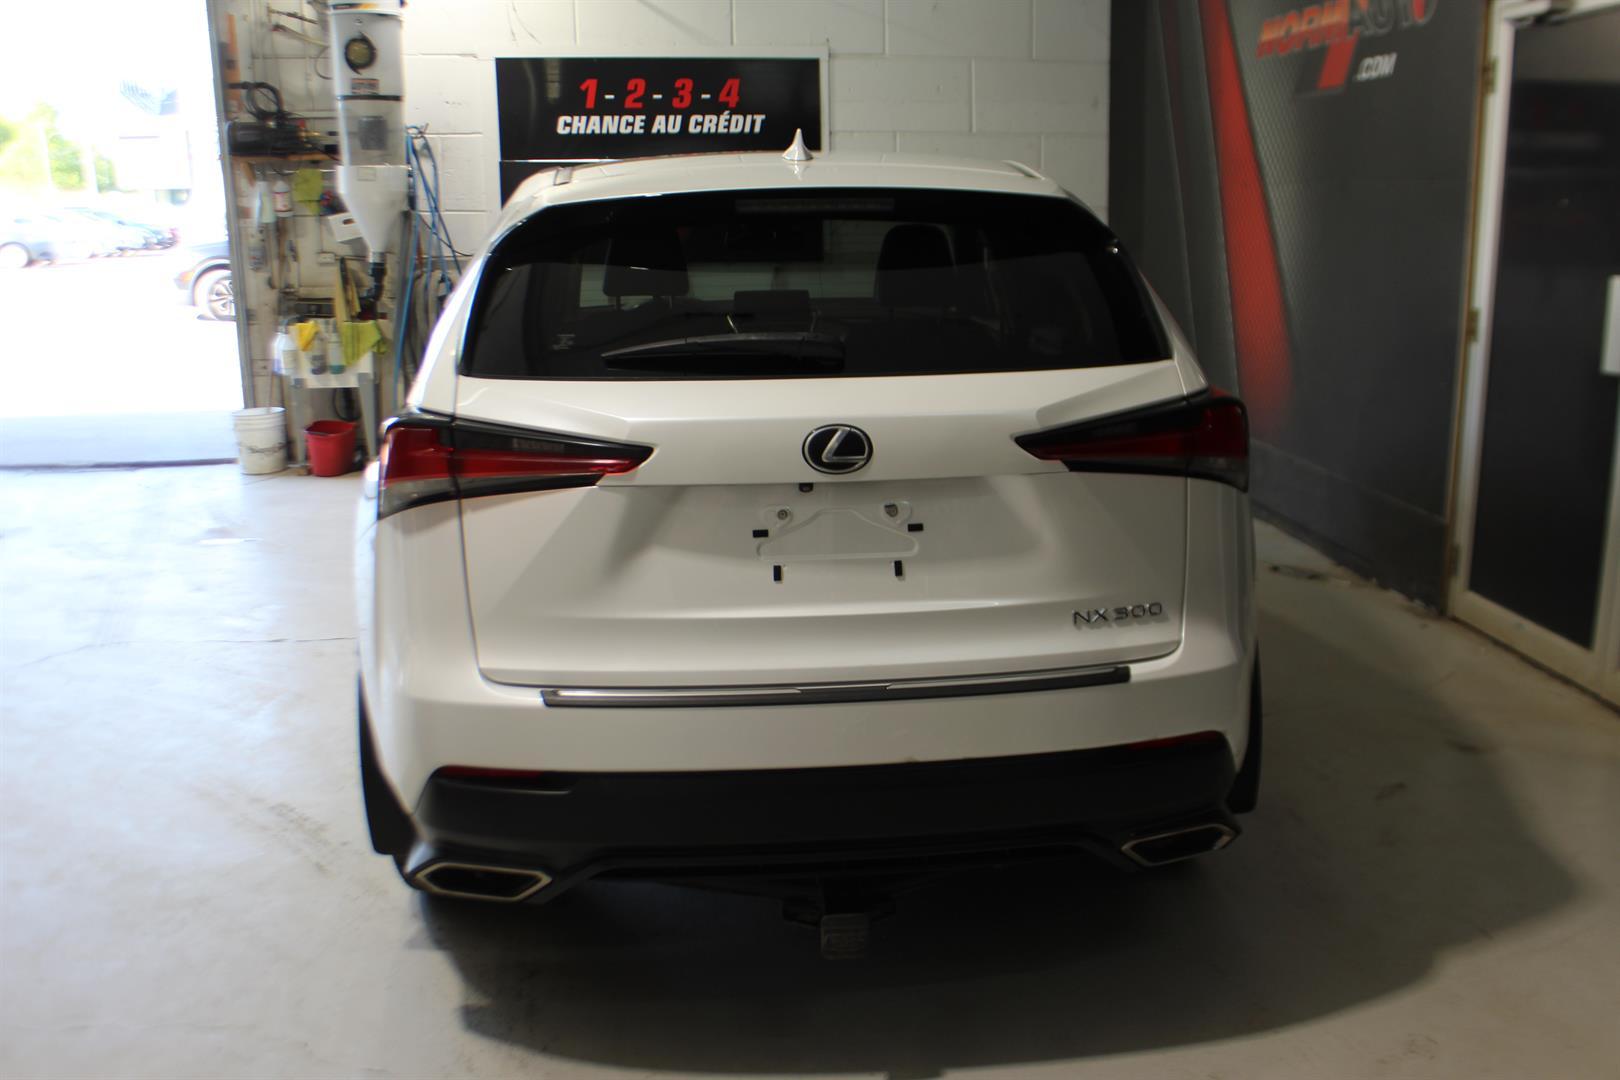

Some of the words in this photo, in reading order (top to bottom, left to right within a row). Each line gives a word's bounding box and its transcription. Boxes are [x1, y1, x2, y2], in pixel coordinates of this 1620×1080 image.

[556, 116, 646, 135] CHANCE
[651, 115, 682, 135] AU
[688, 110, 766, 135] CRÉDIT
[1073, 608, 1109, 626] NX
[1113, 602, 1163, 622] 300
